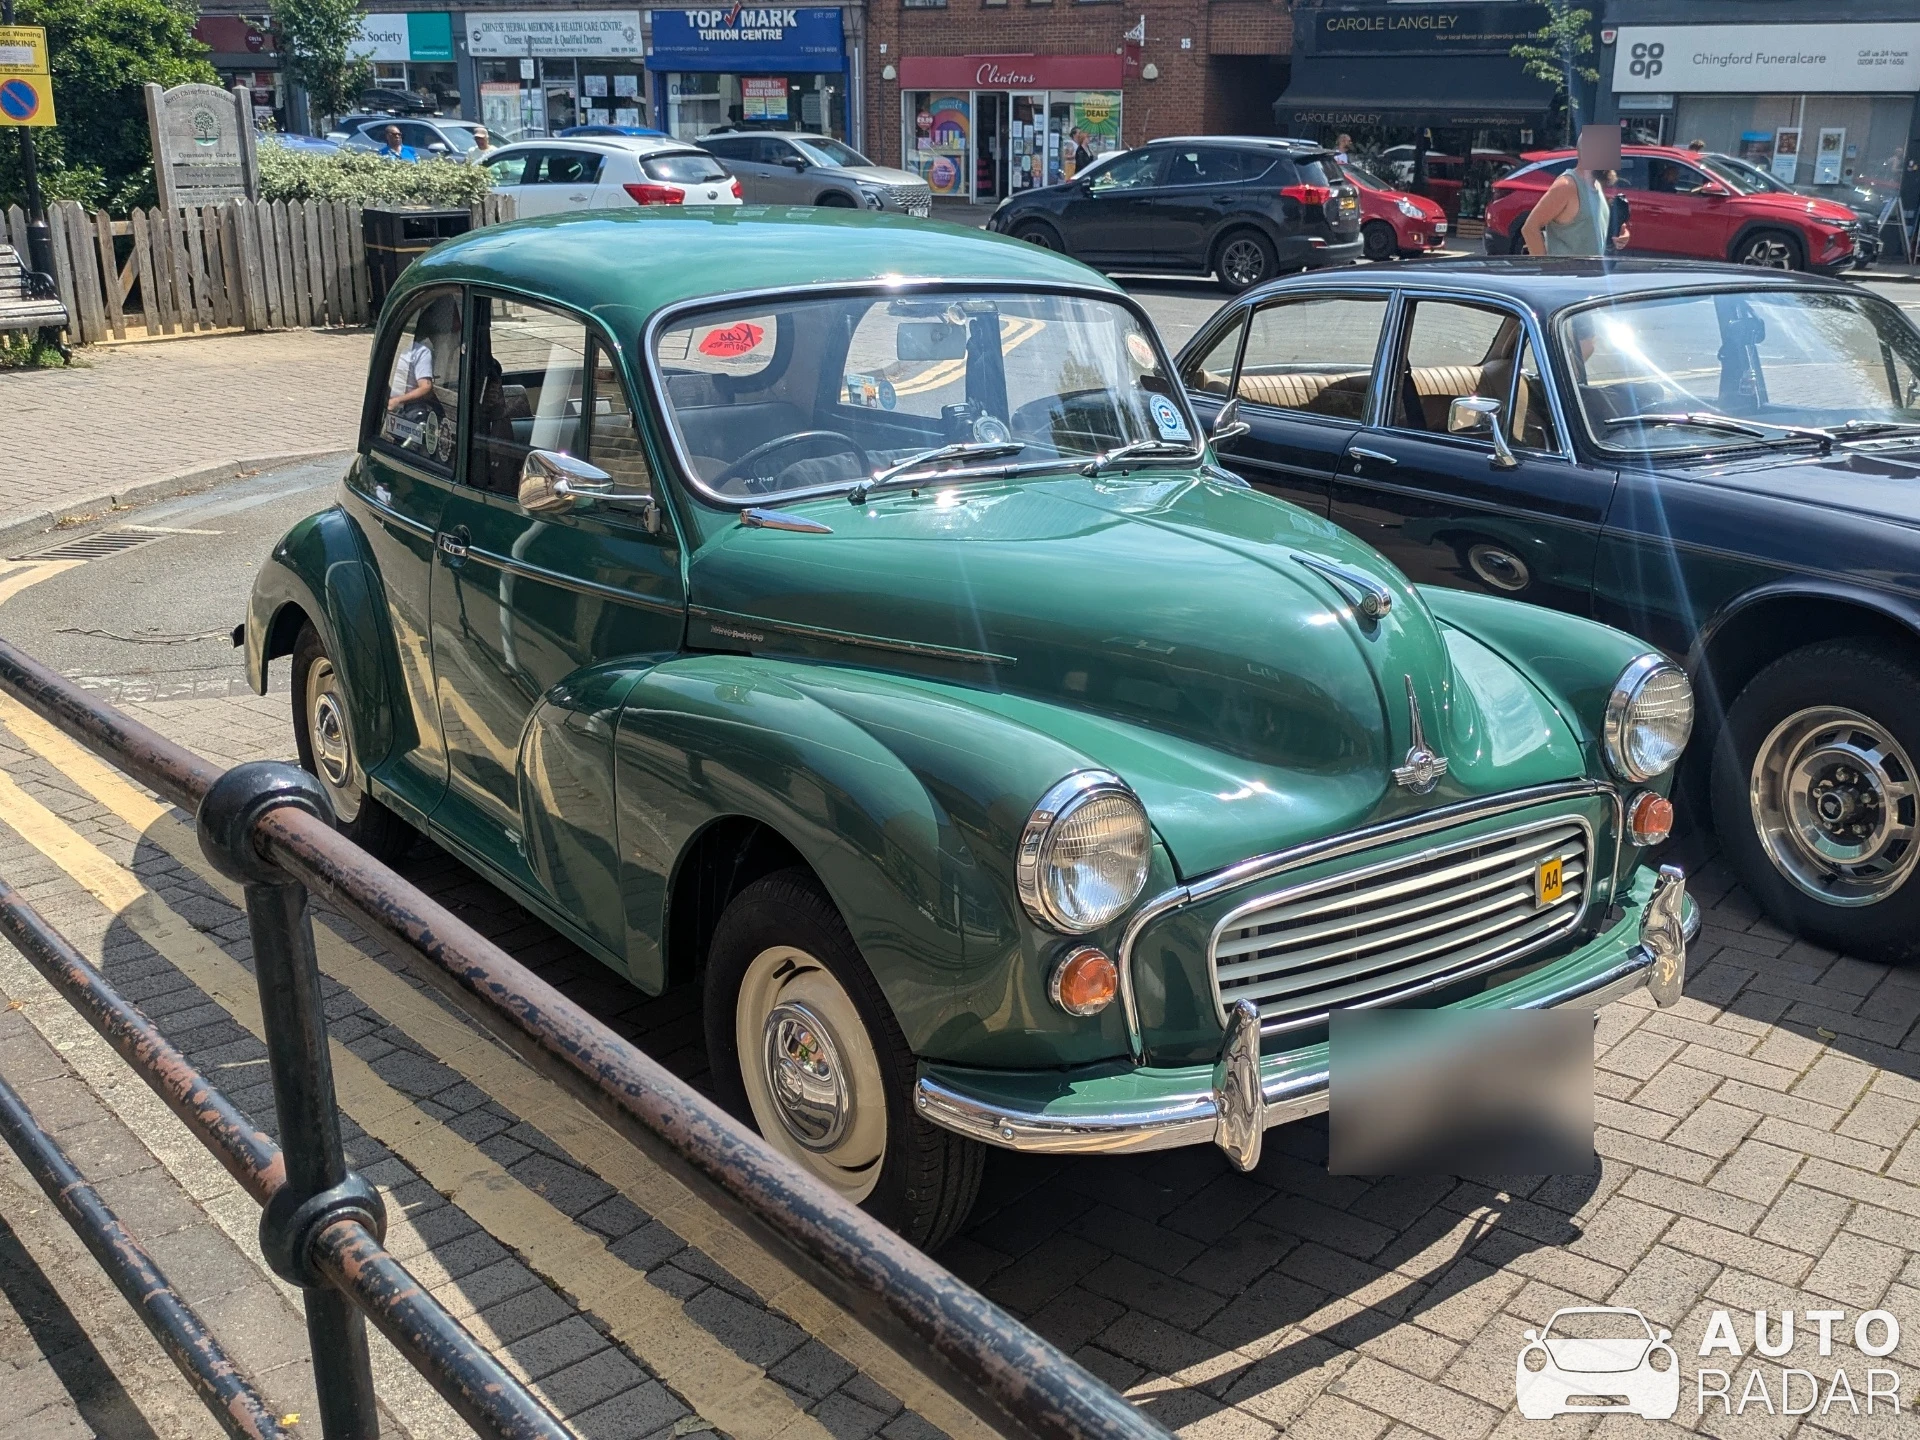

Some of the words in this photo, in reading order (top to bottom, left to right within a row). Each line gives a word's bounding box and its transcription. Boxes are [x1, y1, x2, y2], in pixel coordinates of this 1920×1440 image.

[686, 10, 722, 27] TOP
[741, 10, 797, 27] MARK
[1326, 17, 1384, 31] CAROLE
[1388, 15, 1458, 30] LANGLEY
[481, 22, 504, 32] CHINESE
[505, 22, 526, 32] HERBAL
[528, 22, 554, 32] MEDICINE
[561, 22, 583, 32] HEALTH
[584, 21, 599, 31] CARE
[600, 21, 622, 31] CENTRE
[367, 31, 403, 45] Society
[503, 35, 522, 45] Chinese
[560, 34, 582, 46] Qualified
[583, 34, 602, 44] Doctors
[699, 29, 739, 40] TUITION
[741, 29, 782, 40] CENTRE
[880, 43, 887, 53] 37
[1181, 38, 1191, 48] 35
[1692, 53, 1752, 67] Chingford
[1755, 52, 1826, 64] Funeralcare
[976, 63, 1036, 84] Clintons
[164, 93, 180, 105] North
[180, 88, 209, 97] Chingford
[764, 88, 786, 96] COURSE
[1082, 98, 1111, 107] PAYDAY
[1294, 113, 1334, 123] CAROLE
[1335, 114, 1381, 124] LANGLEY
[1544, 868, 1559, 892] AA
